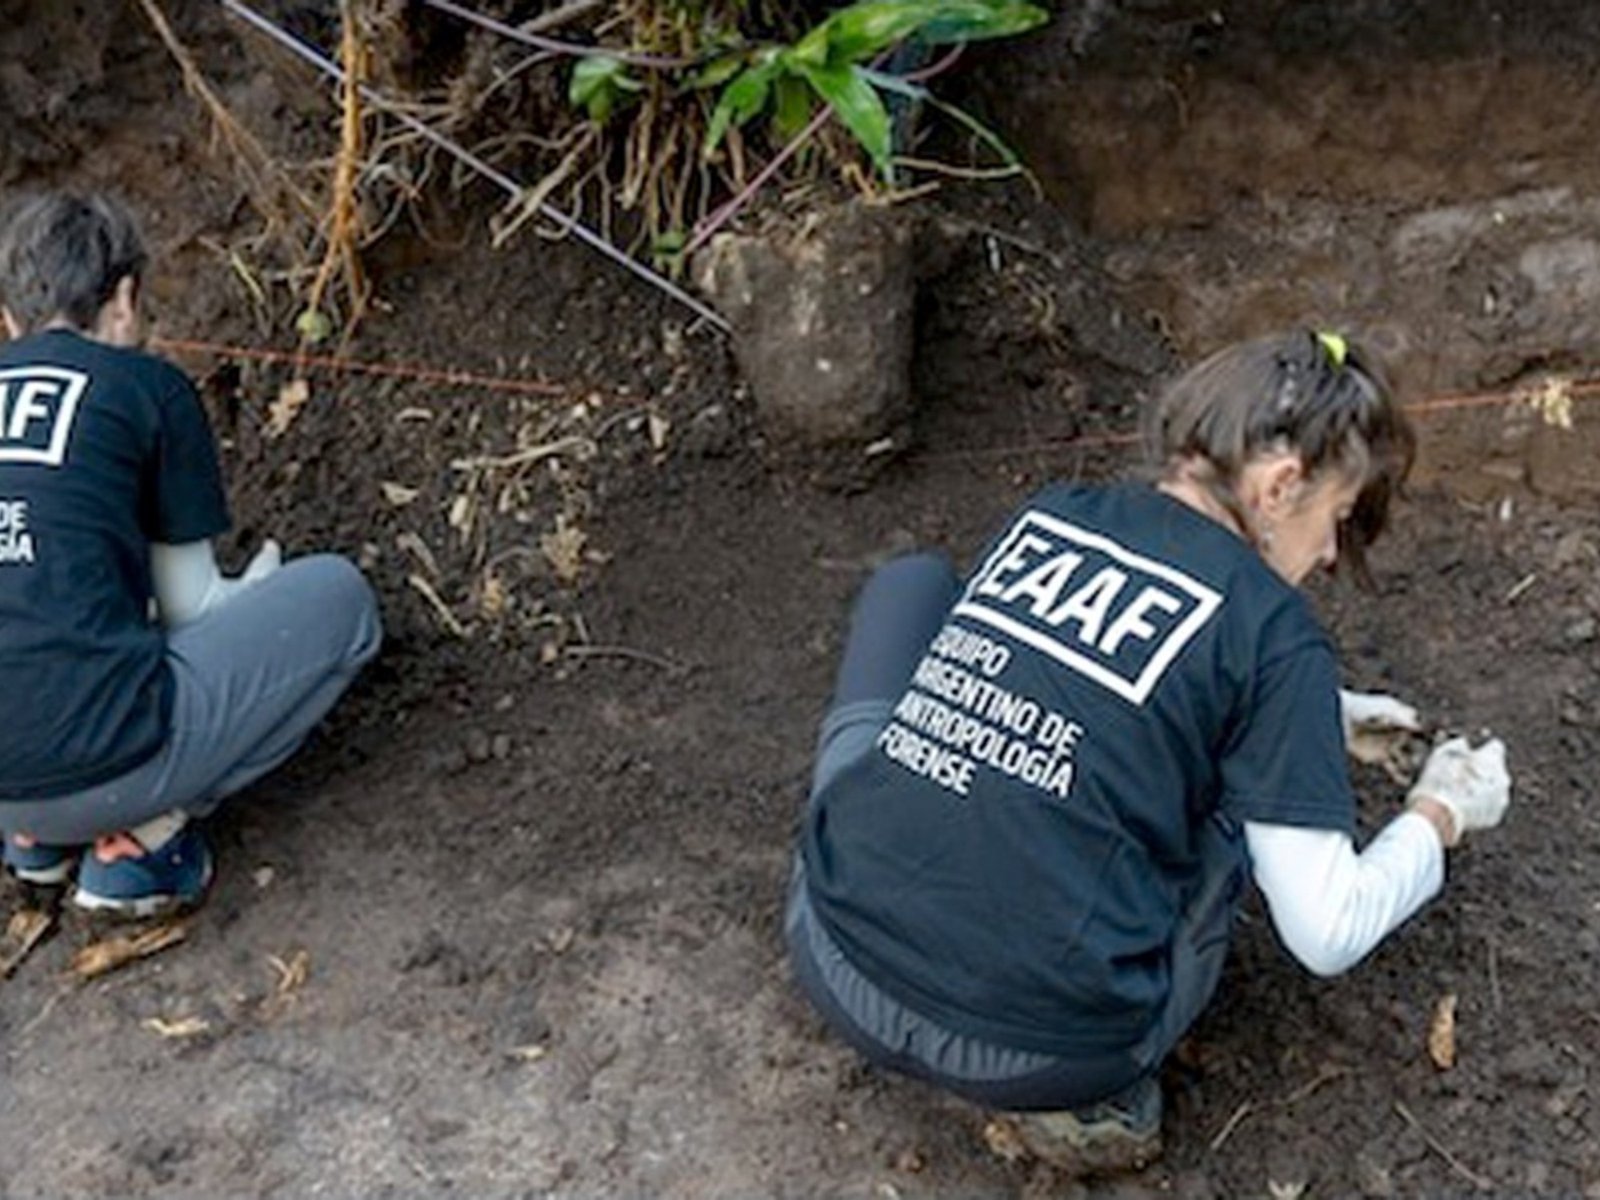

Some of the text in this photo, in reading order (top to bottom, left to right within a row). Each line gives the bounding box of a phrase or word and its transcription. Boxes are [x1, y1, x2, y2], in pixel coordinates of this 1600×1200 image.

[977, 532, 1182, 656] EAAF
[877, 722, 977, 795] FORENSE
[894, 690, 1074, 797] ANTROPOLOGÍA
[1037, 712, 1084, 757] DE
